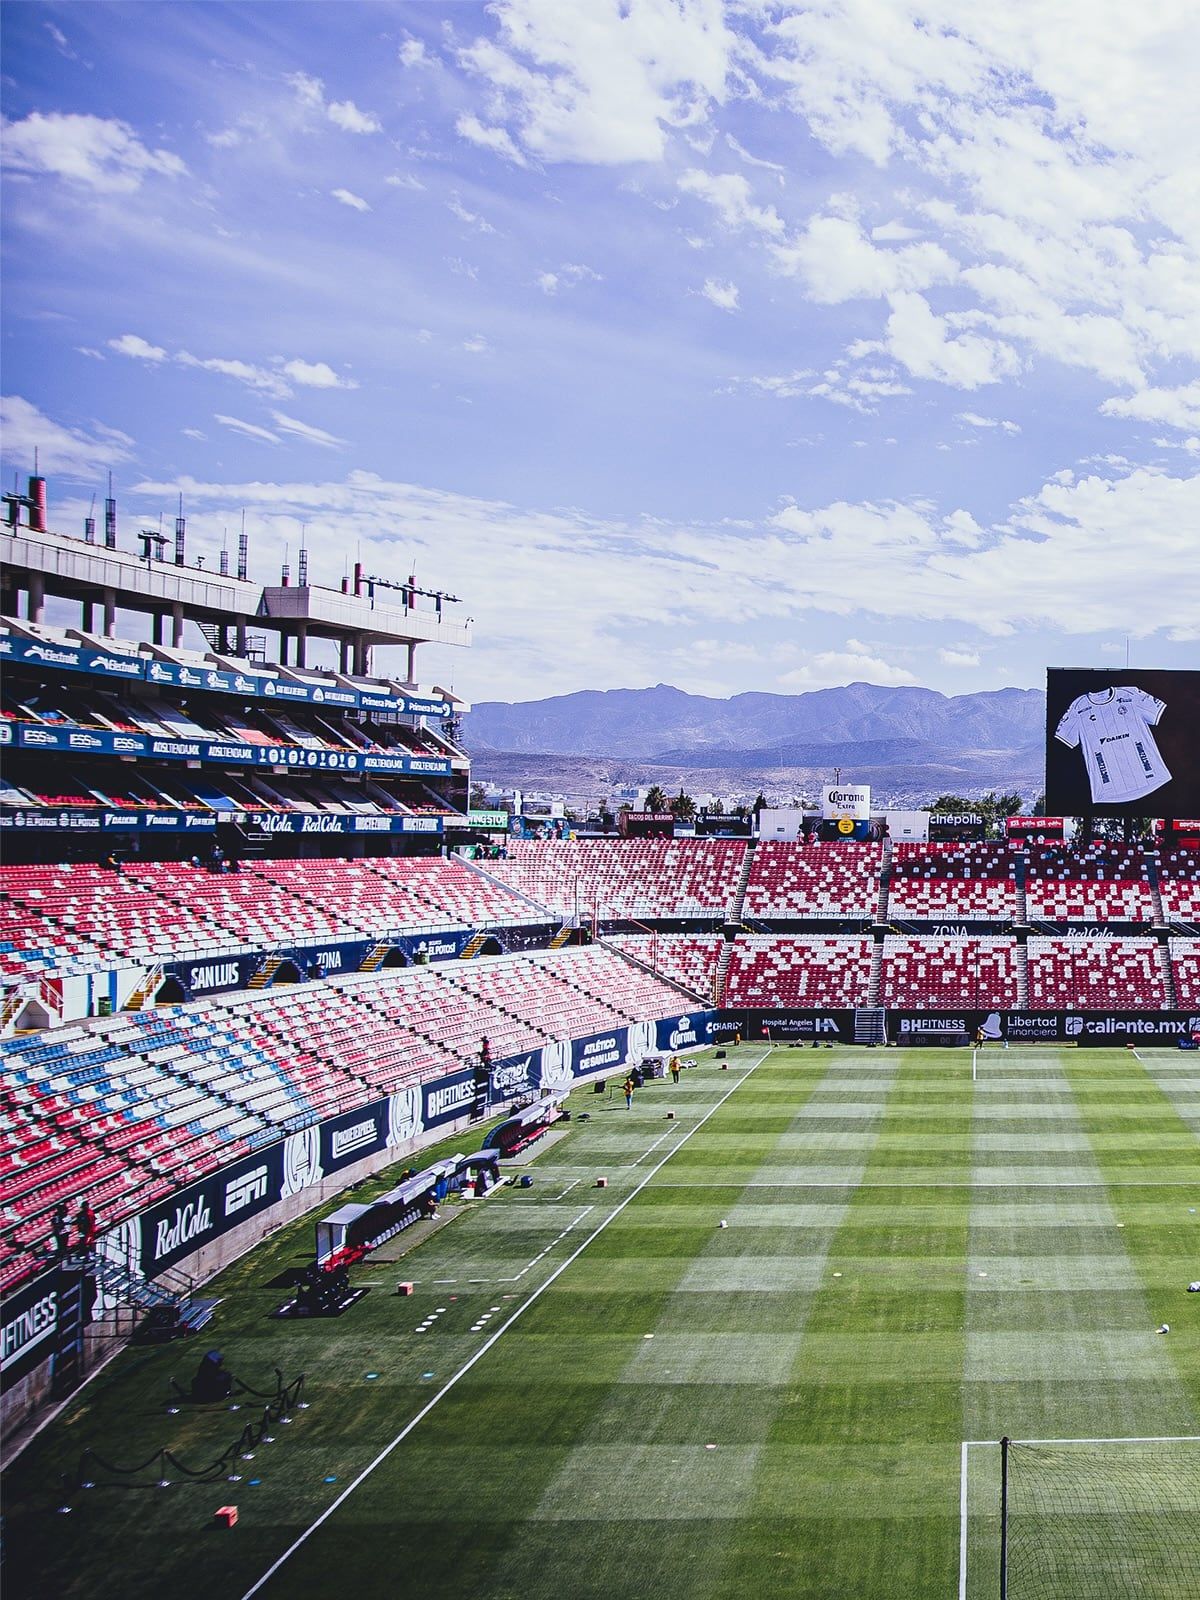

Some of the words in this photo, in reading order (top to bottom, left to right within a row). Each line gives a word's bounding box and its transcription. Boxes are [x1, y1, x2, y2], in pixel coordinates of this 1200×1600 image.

[930, 813, 983, 826] cinépolis
[190, 966, 217, 990] SAN
[215, 962, 239, 987] LUIS
[762, 1019, 787, 1027] Hospital
[789, 1019, 814, 1027] Angeles
[1007, 1016, 1057, 1027] Libertad
[1086, 1018, 1187, 1033] caliente.mx
[1007, 1027, 1057, 1036] Financiera
[583, 1037, 617, 1056] ATLÉTICO
[669, 1029, 697, 1050] Corona
[579, 1057, 591, 1070] DE
[590, 1053, 604, 1067] SAN
[604, 1050, 620, 1064] LUIS
